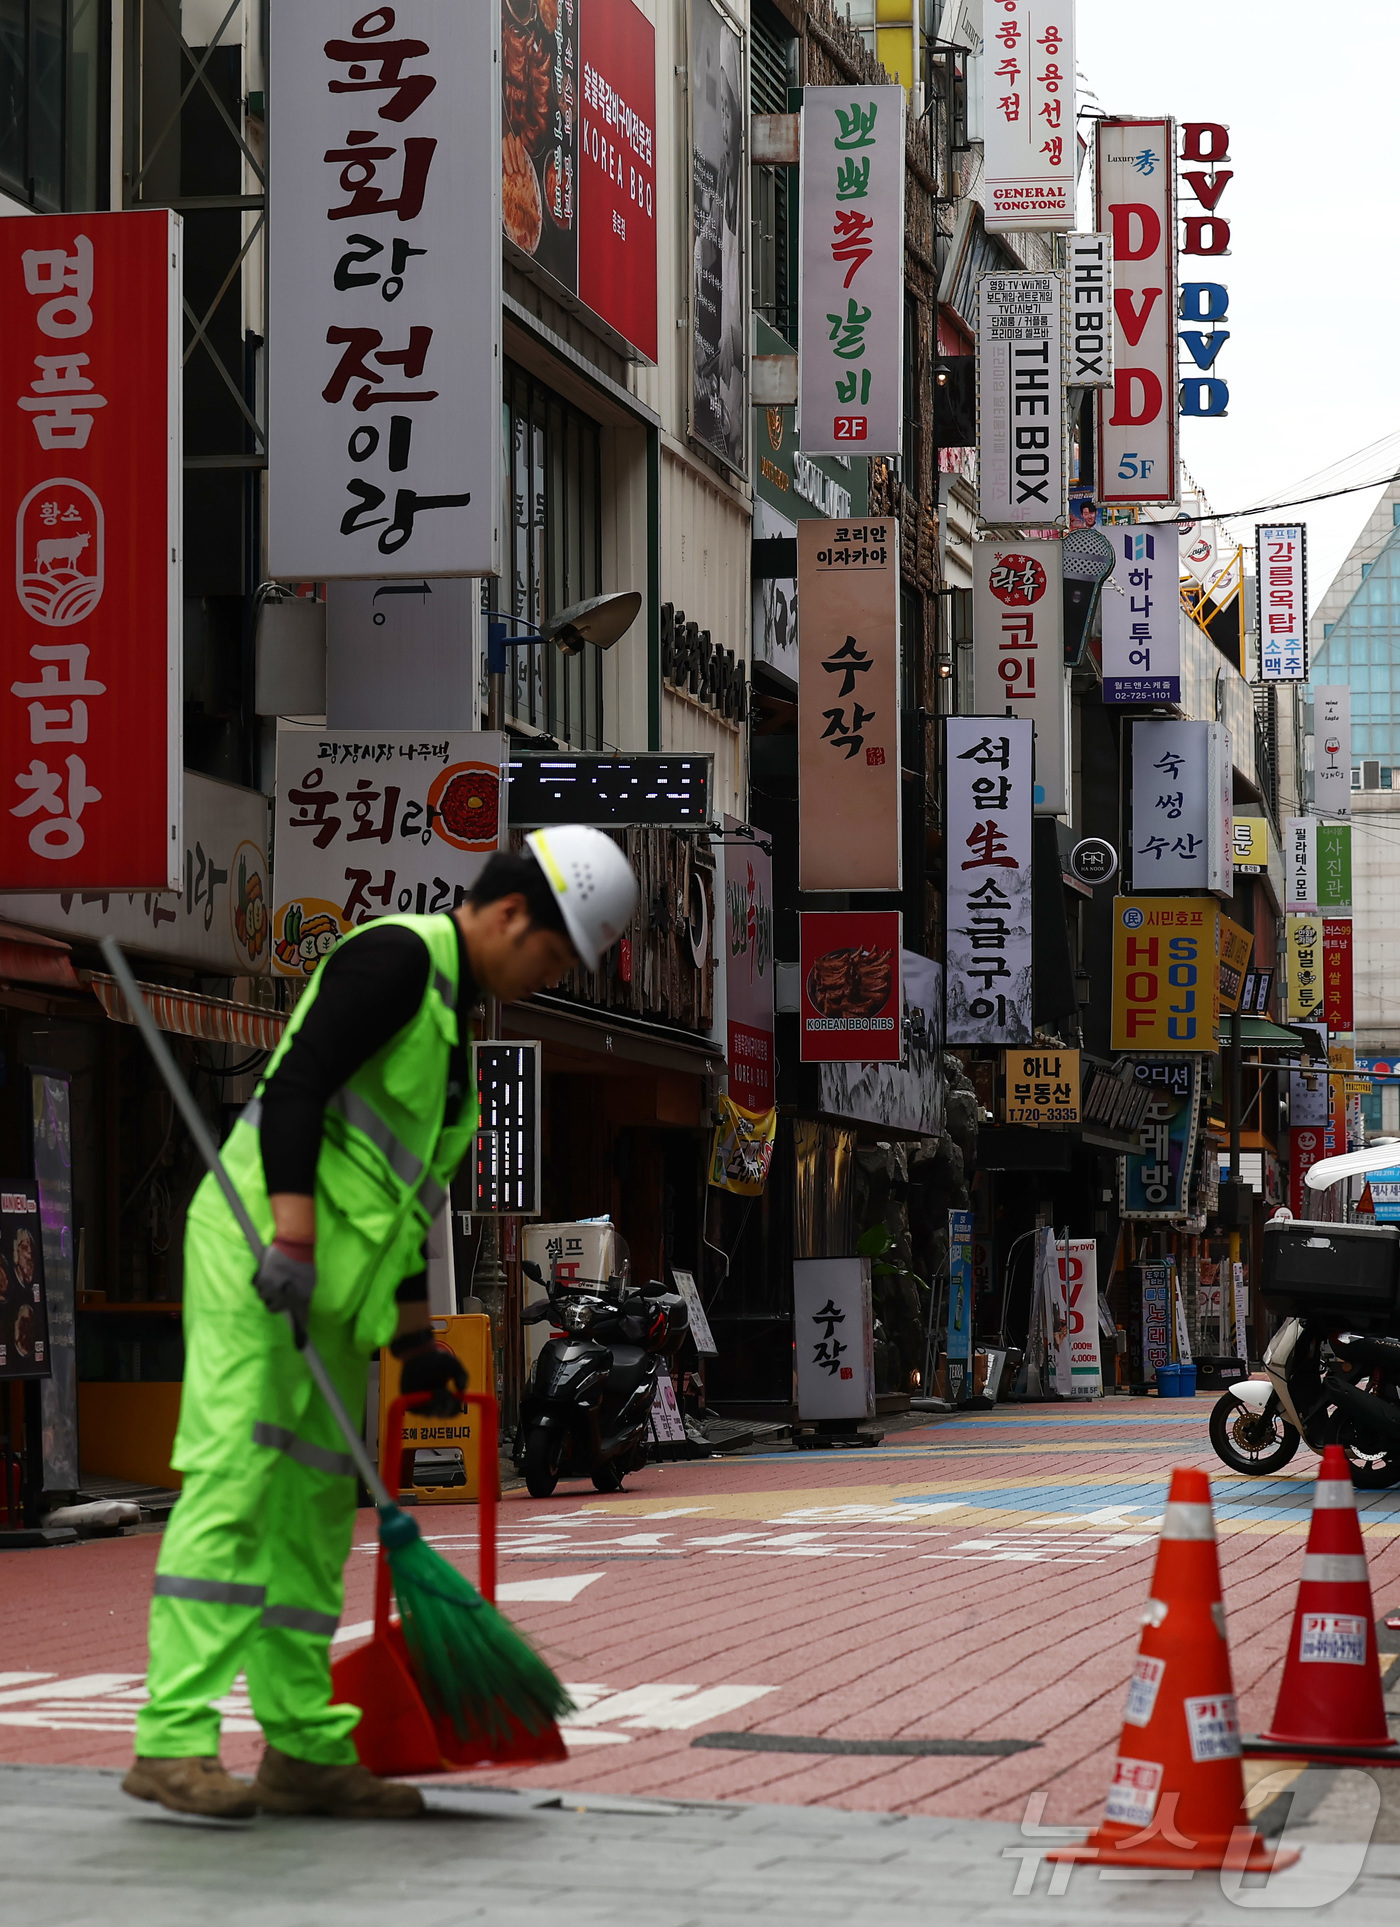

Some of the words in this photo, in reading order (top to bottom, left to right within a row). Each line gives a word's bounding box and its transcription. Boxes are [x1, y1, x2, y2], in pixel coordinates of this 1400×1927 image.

[1036, 25, 1064, 166] 용용선생
[583, 61, 652, 169] 숯불쪽갈비구이전문점
[323, 6, 437, 301] 육회랑
[583, 117, 624, 190] KOREA
[629, 165, 653, 219] BBQ
[993, 186, 1066, 200] GENERAL
[994, 199, 1066, 211] YONGYONG
[1179, 122, 1234, 256] DVD
[612, 209, 626, 242] 종로점
[1073, 242, 1103, 304] THE
[991, 316, 1016, 327] 단체룸
[1024, 315, 1048, 326] 커플룸
[998, 303, 1042, 314] TV다시보기
[1109, 203, 1164, 427] DVD
[17, 234, 108, 450] 명품
[990, 328, 1022, 339] 프리미엄
[1025, 327, 1050, 338] 셀프바
[1073, 312, 1103, 377] BOX
[1178, 281, 1231, 417] DVD
[1014, 341, 1049, 416] THE
[321, 325, 471, 554] 전이랑
[837, 418, 865, 438] 2F
[1015, 426, 1050, 505] BOX
[1117, 453, 1155, 480] 5F
[40, 501, 83, 526] 황소
[833, 525, 887, 544] 코리안
[1263, 529, 1298, 539] 루프탑
[816, 547, 888, 566] 이자카야
[991, 560, 1041, 602] 락휴
[1267, 542, 1297, 634] 강릉옥탑
[1128, 568, 1154, 671] 하나투어
[998, 612, 1038, 699] 코인
[1264, 638, 1302, 655] 소주
[1264, 657, 1302, 675] 맥주
[819, 635, 876, 760] 수작
[1114, 680, 1171, 690] 월드앤스케줄
[1114, 691, 1171, 700] 02-725-1101
[8, 643, 107, 860] 곱창
[317, 742, 395, 764] 광장시장
[398, 741, 451, 764] 나주댁
[1152, 751, 1186, 819] 숙썽
[288, 768, 442, 849] 육회랑
[1137, 833, 1203, 861] 수산
[1294, 828, 1308, 901] 필라테스모브
[1325, 838, 1343, 898] 사진관
[1147, 911, 1203, 926] 시민호프
[1126, 937, 1159, 1038] HOF
[1168, 937, 1198, 1040] SOJU
[1328, 952, 1342, 1024] 생쌀국수
[806, 1018, 843, 1032] KOREAN
[845, 1018, 868, 1032] BBQ
[870, 1017, 894, 1031] RIBS
[1023, 1056, 1062, 1078] 하나
[1014, 1082, 1072, 1105] 부동산
[1008, 1107, 1078, 1122] T.720-3335
[545, 1237, 584, 1259] 셀프
[1080, 1243, 1095, 1251] DVD
[811, 1299, 846, 1377] 수작
[1069, 1342, 1093, 1350] ,000원
[420, 1426, 472, 1440] 감사드립니다
